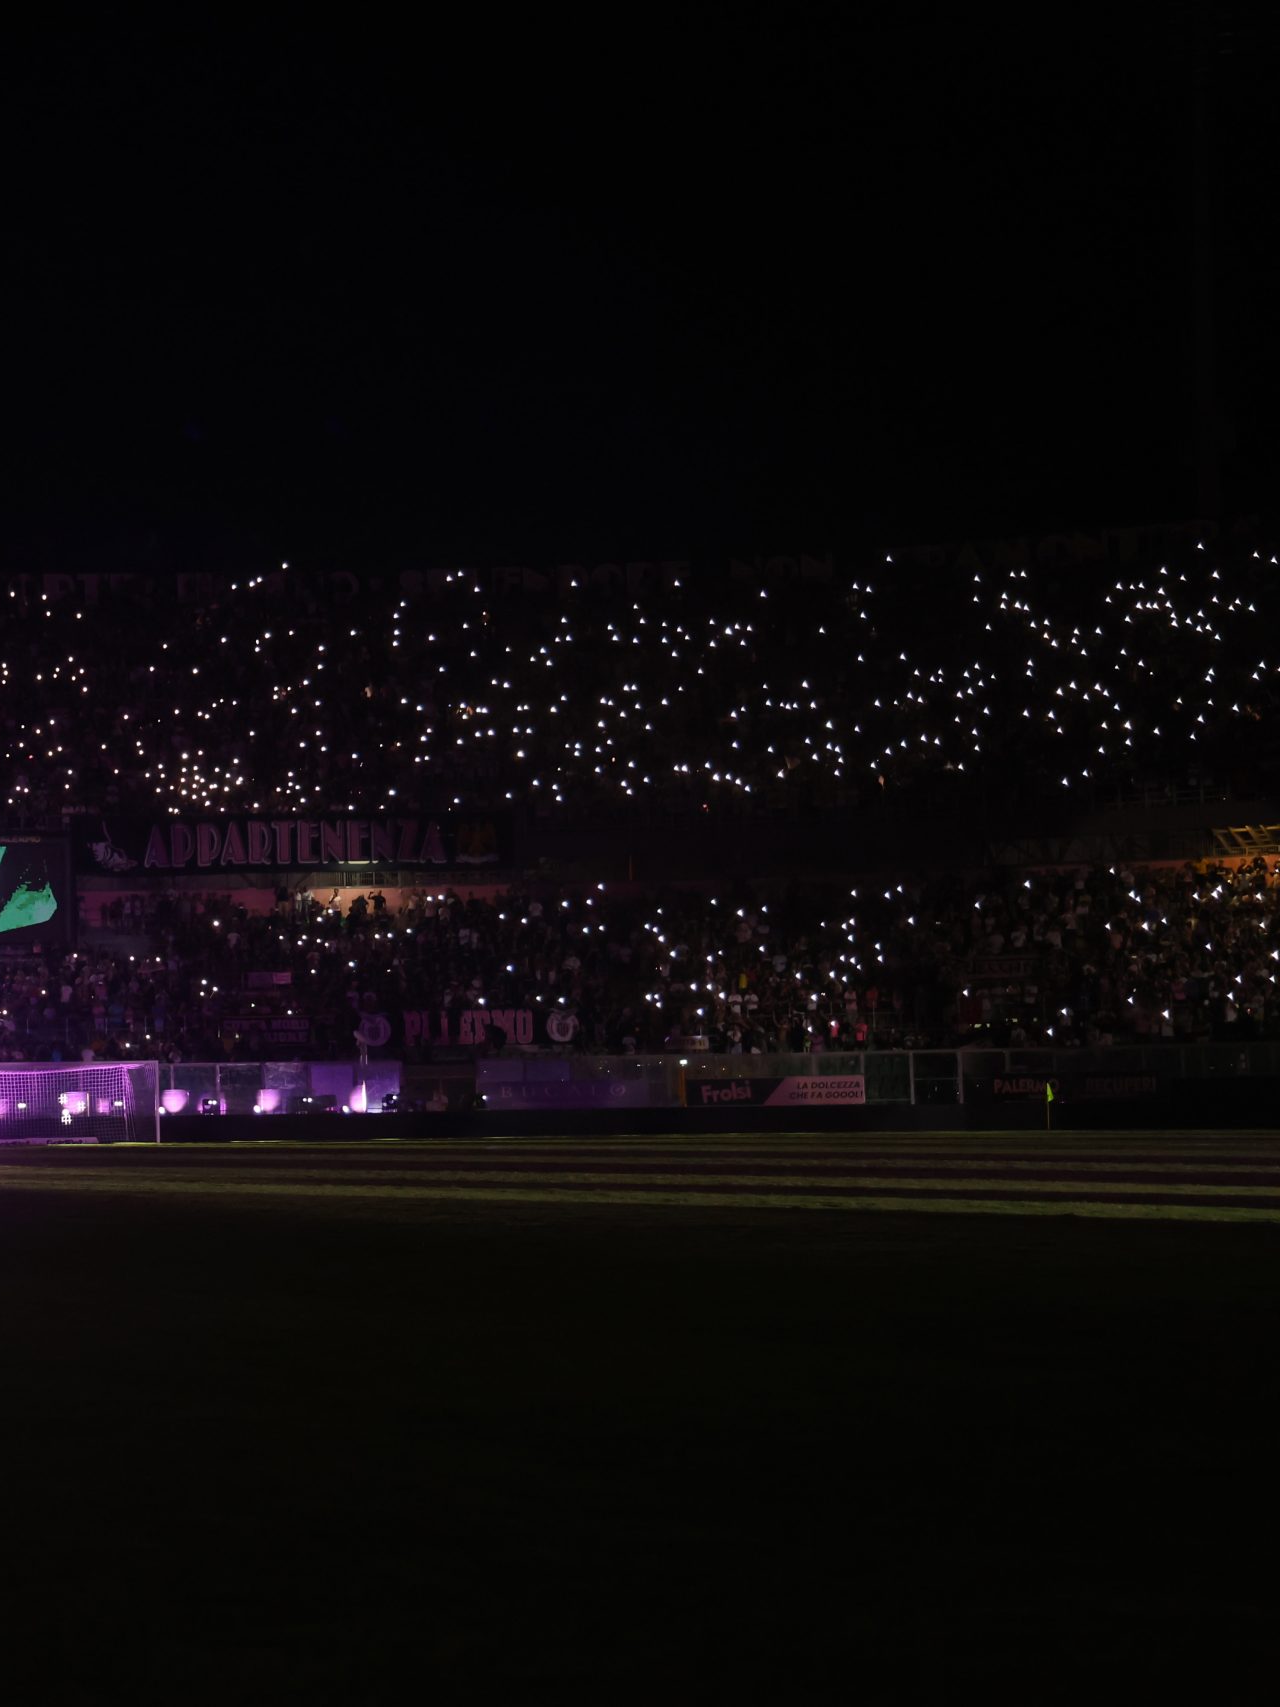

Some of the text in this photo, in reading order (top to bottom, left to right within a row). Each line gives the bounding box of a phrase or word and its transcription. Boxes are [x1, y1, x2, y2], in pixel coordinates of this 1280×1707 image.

[143, 817, 448, 869] APPARTENENZA
[797, 1081, 860, 1090] LA DOLCEZZA
[790, 1092, 808, 1100] CHE
